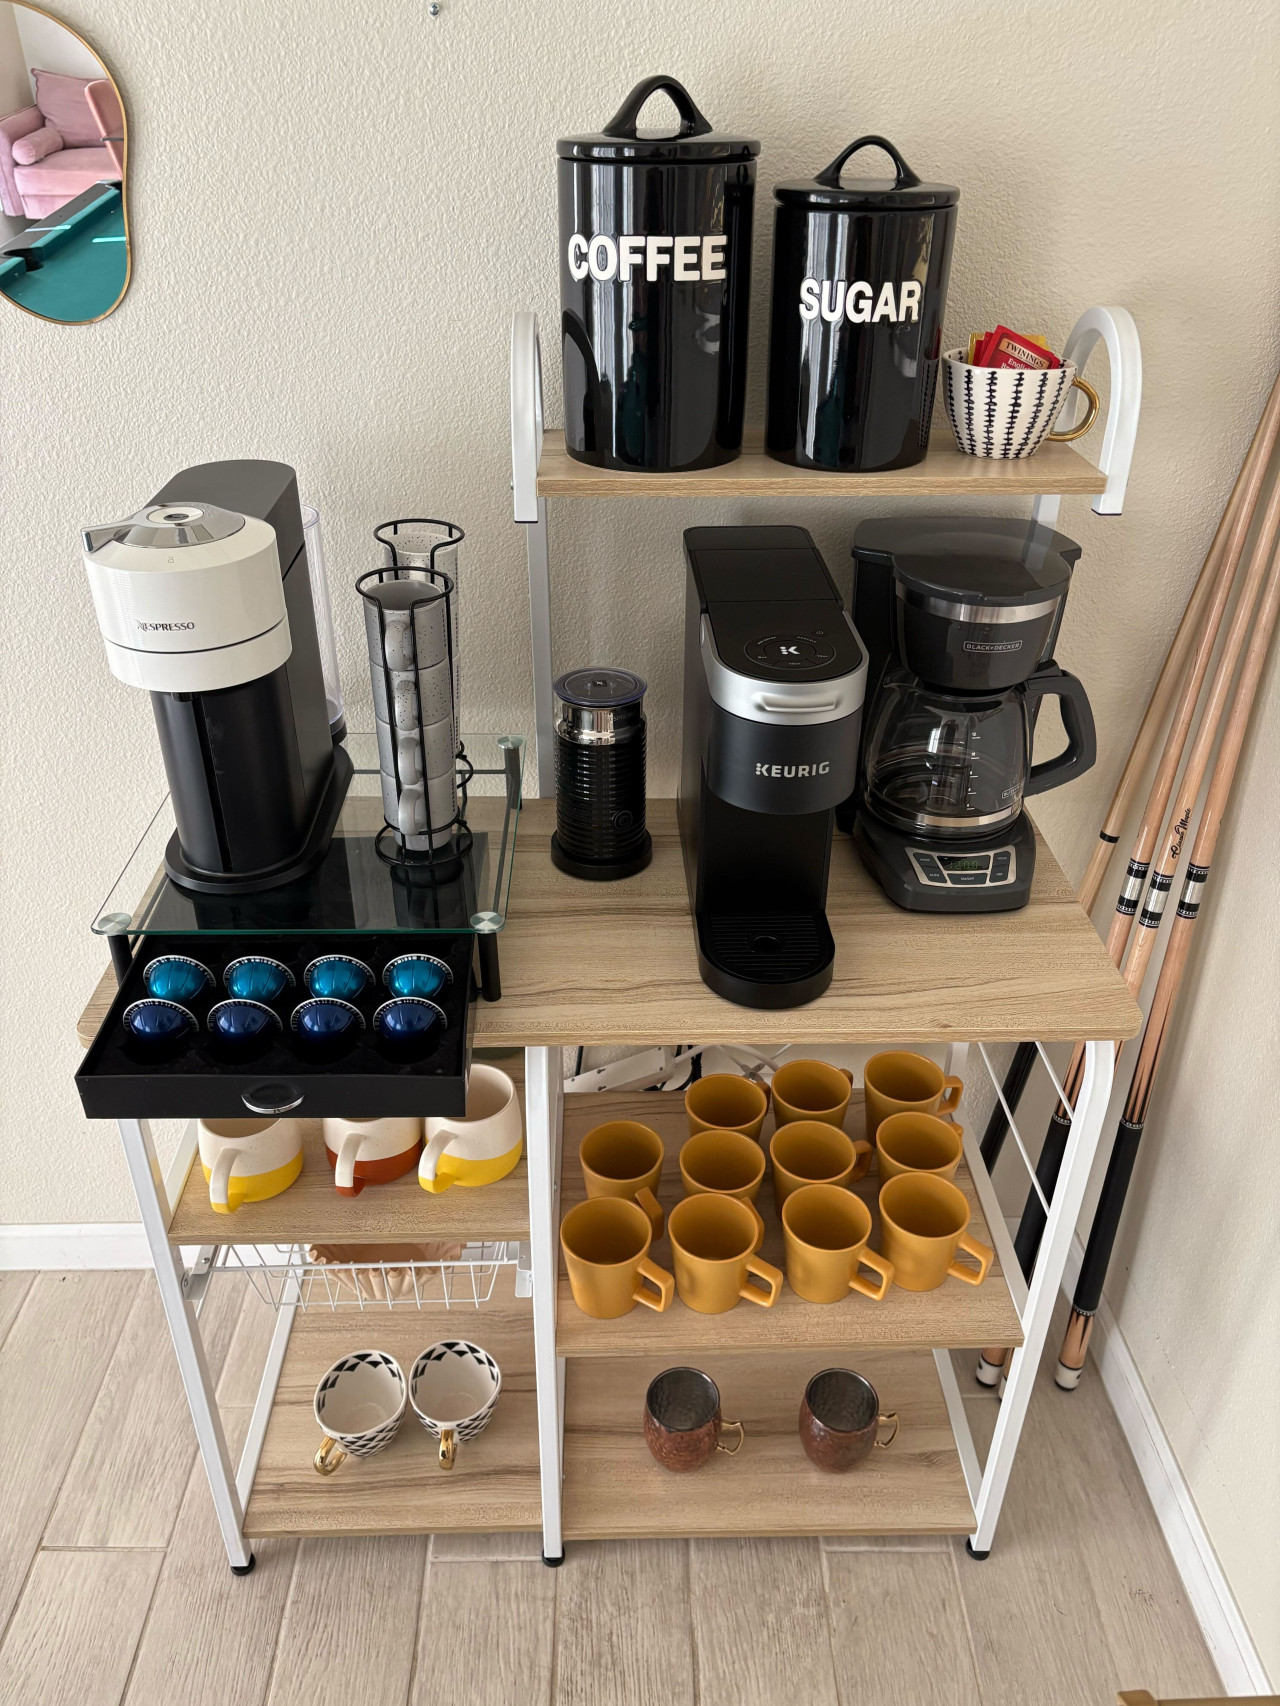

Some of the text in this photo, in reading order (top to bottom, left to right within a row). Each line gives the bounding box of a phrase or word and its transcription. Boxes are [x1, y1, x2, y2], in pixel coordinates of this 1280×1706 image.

[568, 234, 727, 282] COFFEE
[799, 278, 922, 324] SUGAR
[1005, 341, 1045, 368] TWININGS
[136, 620, 195, 633] NESPRESSO
[755, 762, 829, 778] KEURIG
